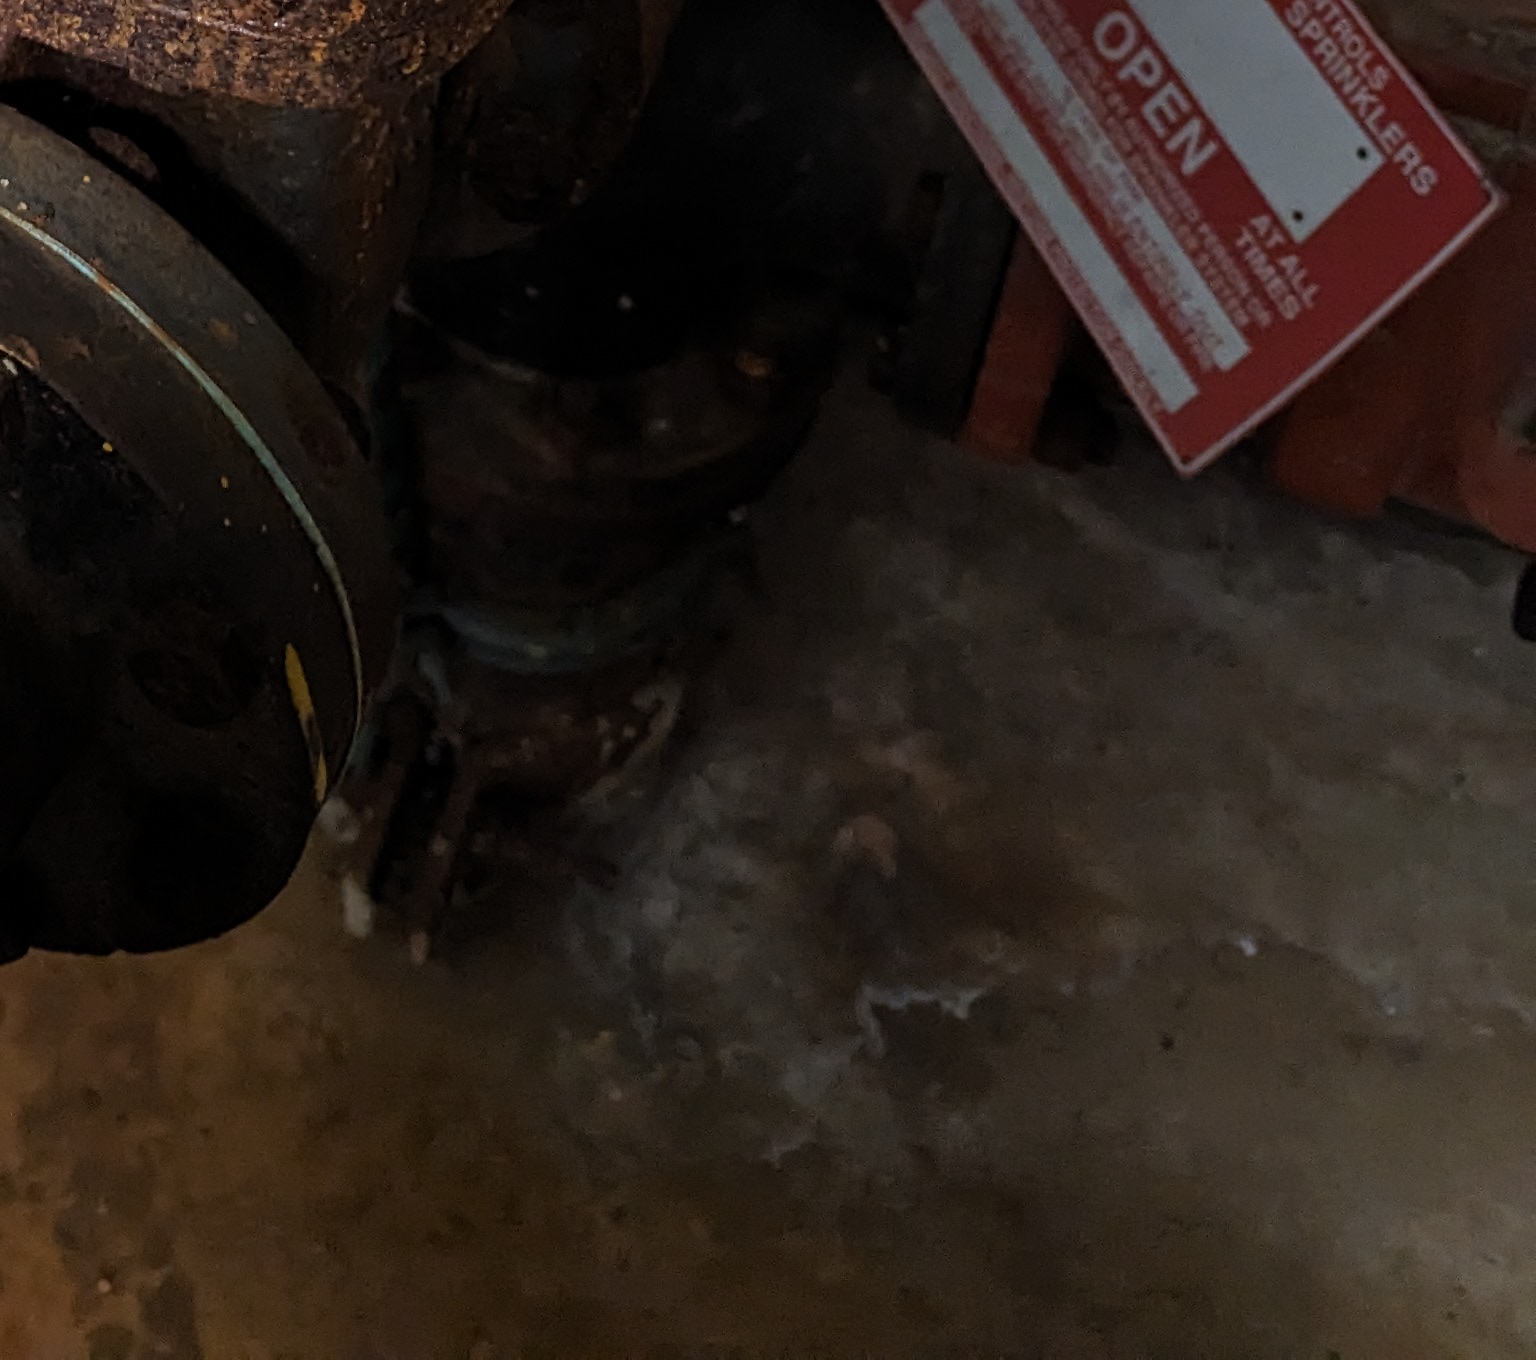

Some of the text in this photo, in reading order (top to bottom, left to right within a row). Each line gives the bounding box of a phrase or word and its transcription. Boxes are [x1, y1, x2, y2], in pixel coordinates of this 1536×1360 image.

[1093, 10, 1218, 175] OPEN
[1285, 0, 1437, 194] SPRINKLERS
[1236, 226, 1300, 319] TIMES
[1249, 214, 1318, 308] AT ALL
